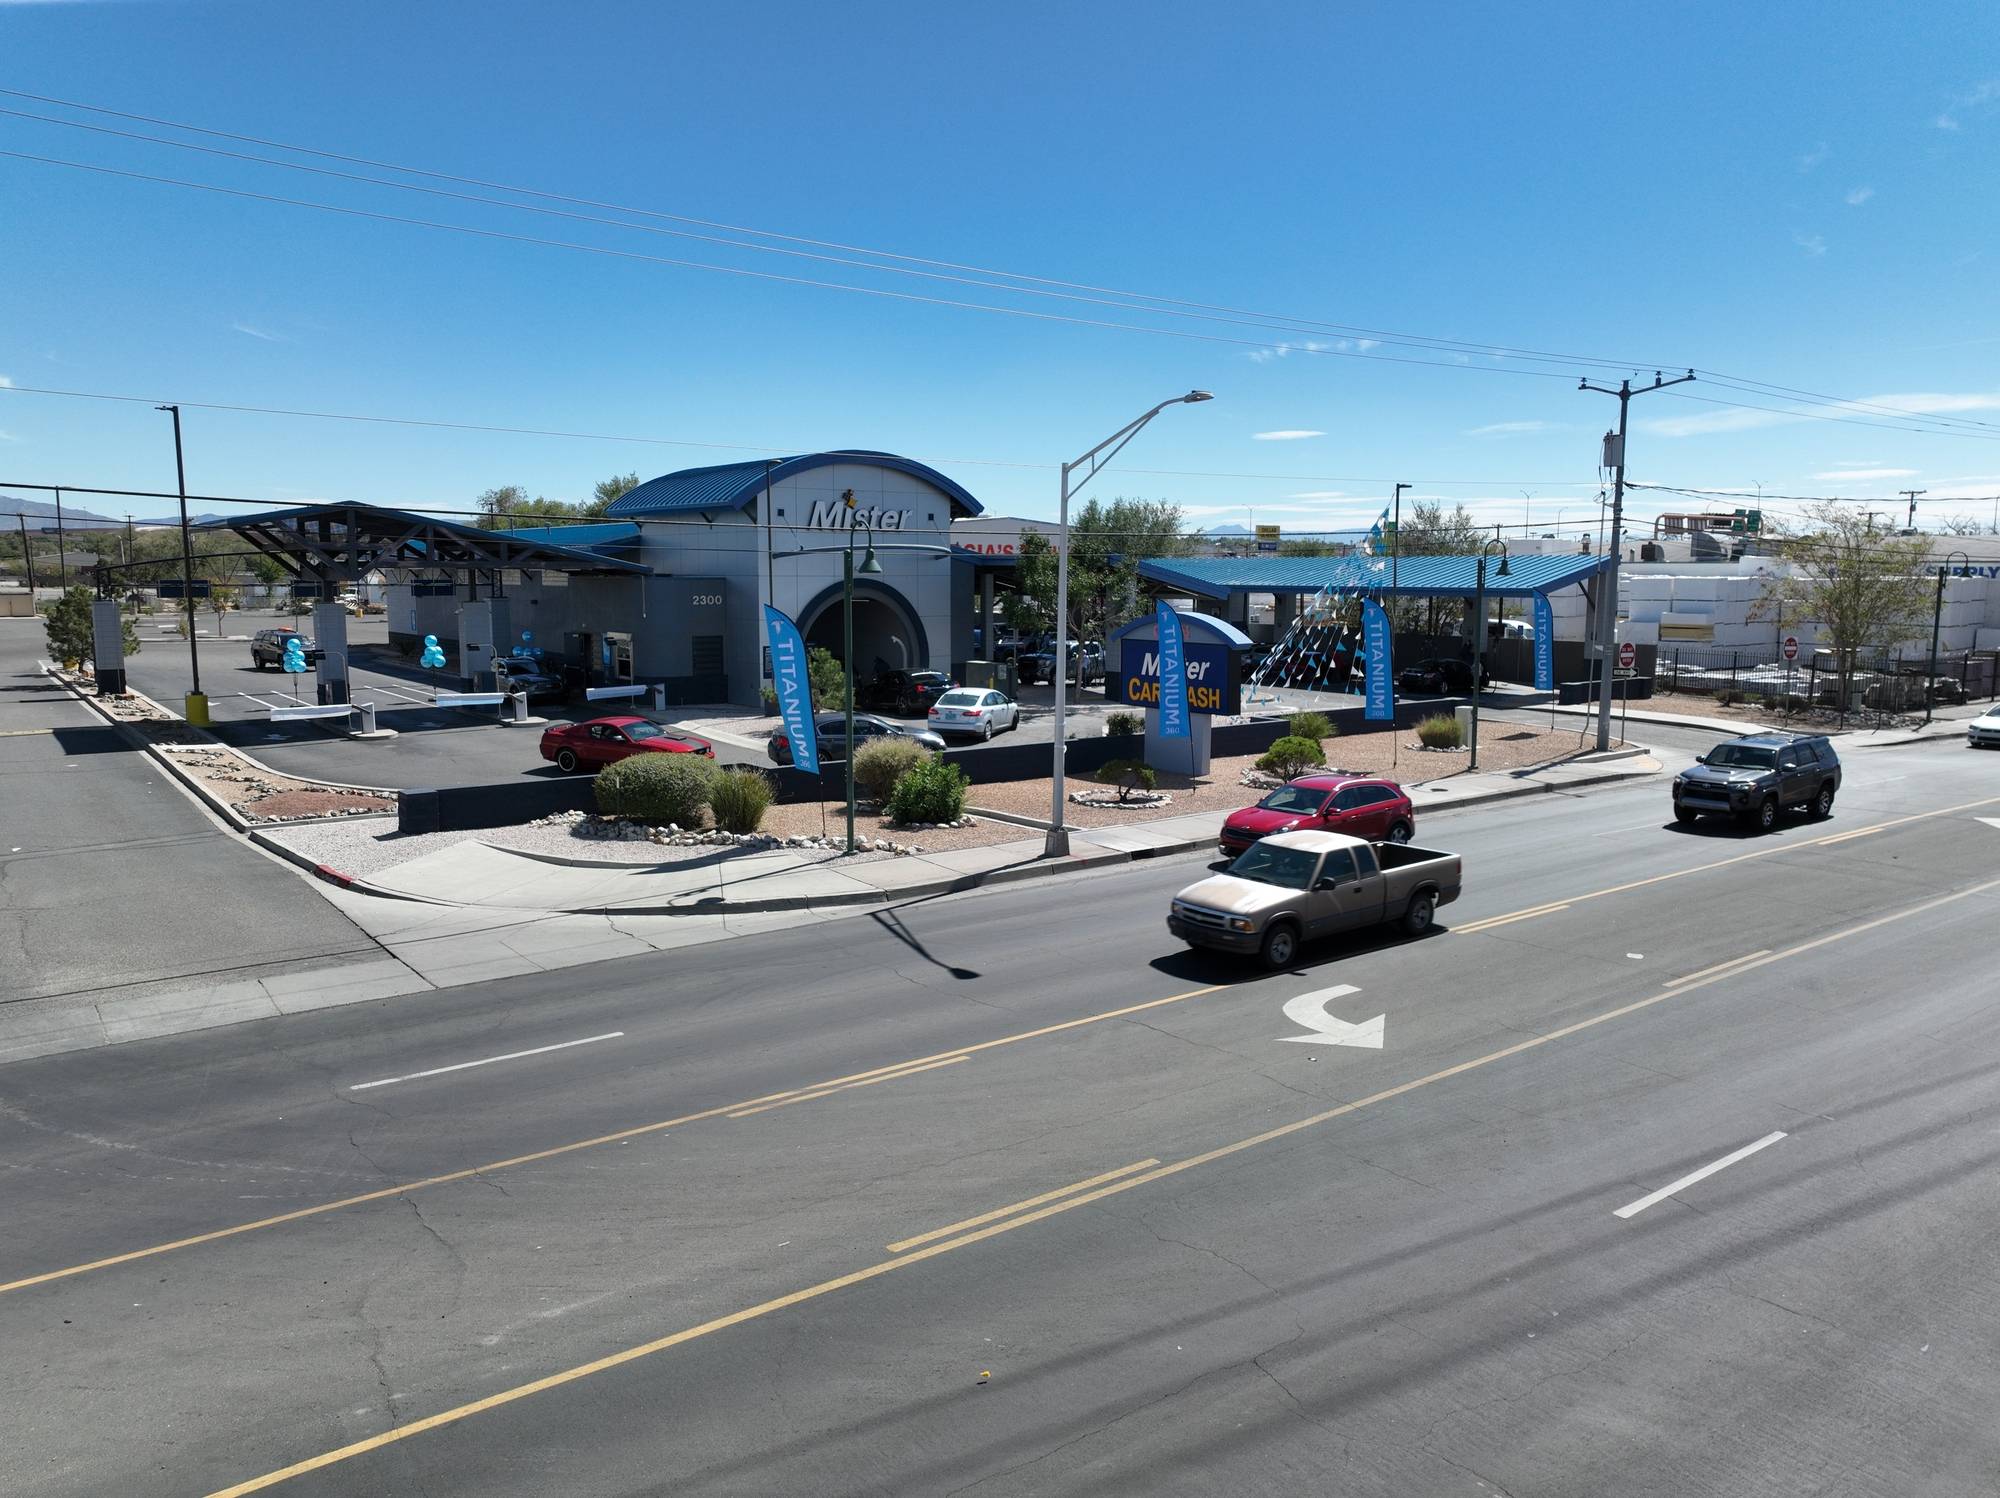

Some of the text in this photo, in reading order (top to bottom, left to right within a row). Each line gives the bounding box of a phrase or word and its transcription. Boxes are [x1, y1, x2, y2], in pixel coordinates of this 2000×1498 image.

[808, 500, 913, 532] Mister
[692, 595, 723, 606] 2300
[1141, 652, 1211, 681] Mer
[1370, 620, 1385, 709] TITANIUM
[1537, 608, 1548, 682] TITANIUM
[778, 637, 810, 759] TITANIUM
[1164, 624, 1180, 726] TITANIUM
[1187, 686, 1221, 710] ASH
